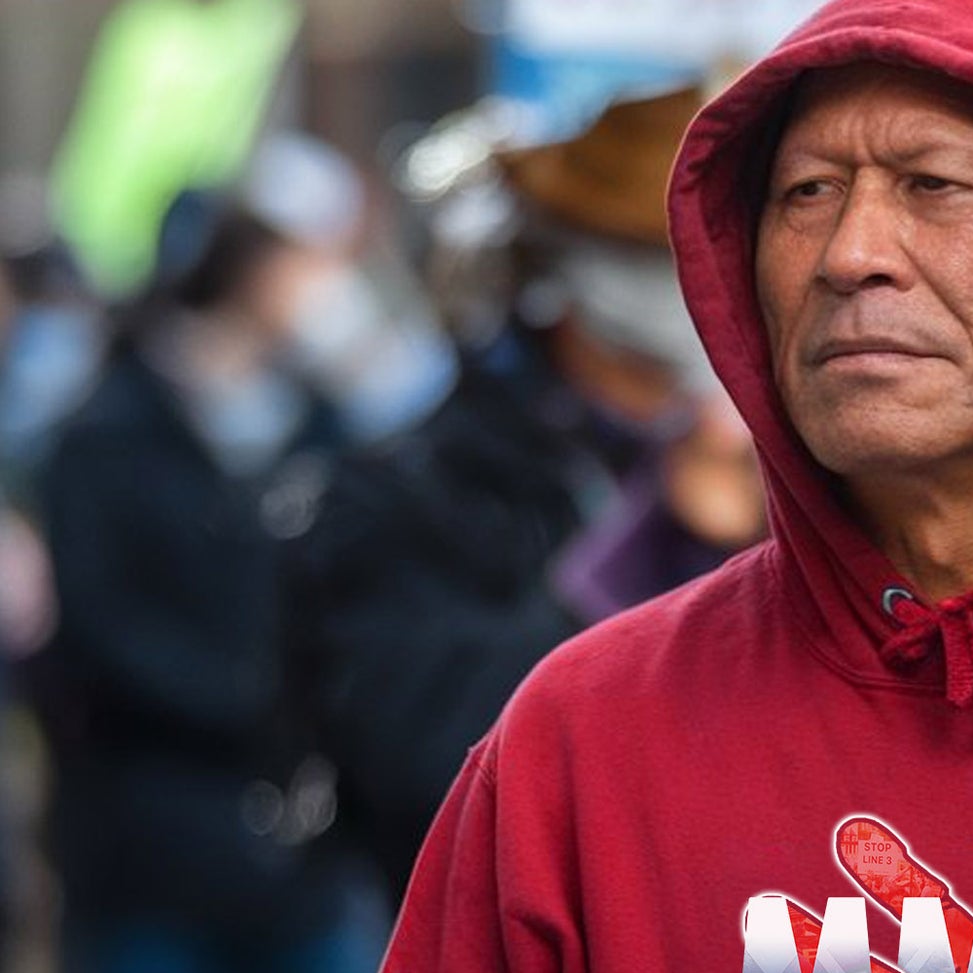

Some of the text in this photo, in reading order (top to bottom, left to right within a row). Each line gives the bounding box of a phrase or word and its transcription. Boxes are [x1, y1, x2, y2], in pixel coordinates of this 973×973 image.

[864, 842, 892, 853] STOP
[862, 855, 893, 865] LINE 3
